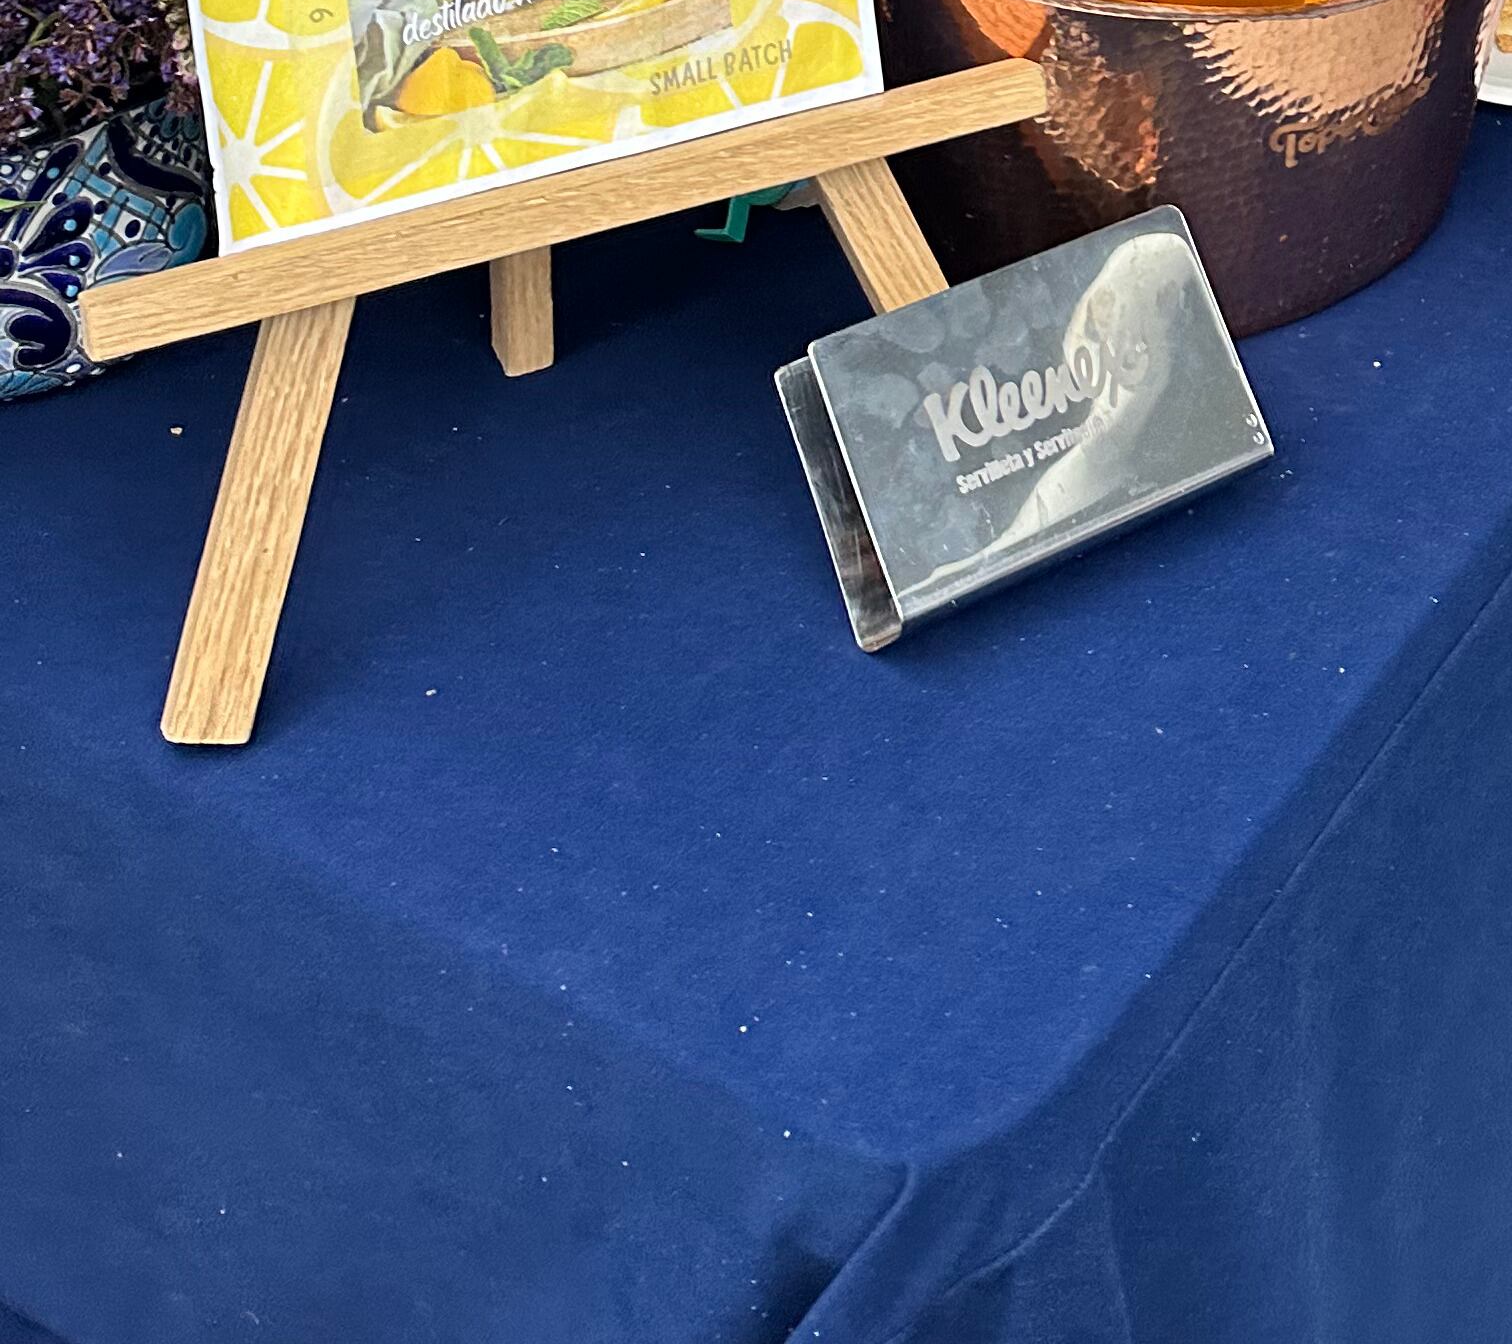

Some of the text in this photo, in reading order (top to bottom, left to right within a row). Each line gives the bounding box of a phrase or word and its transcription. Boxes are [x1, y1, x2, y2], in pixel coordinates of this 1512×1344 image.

[309, 7, 335, 24] 9
[650, 39, 793, 97] SMALL BATCH
[1022, 446, 1035, 468] y
